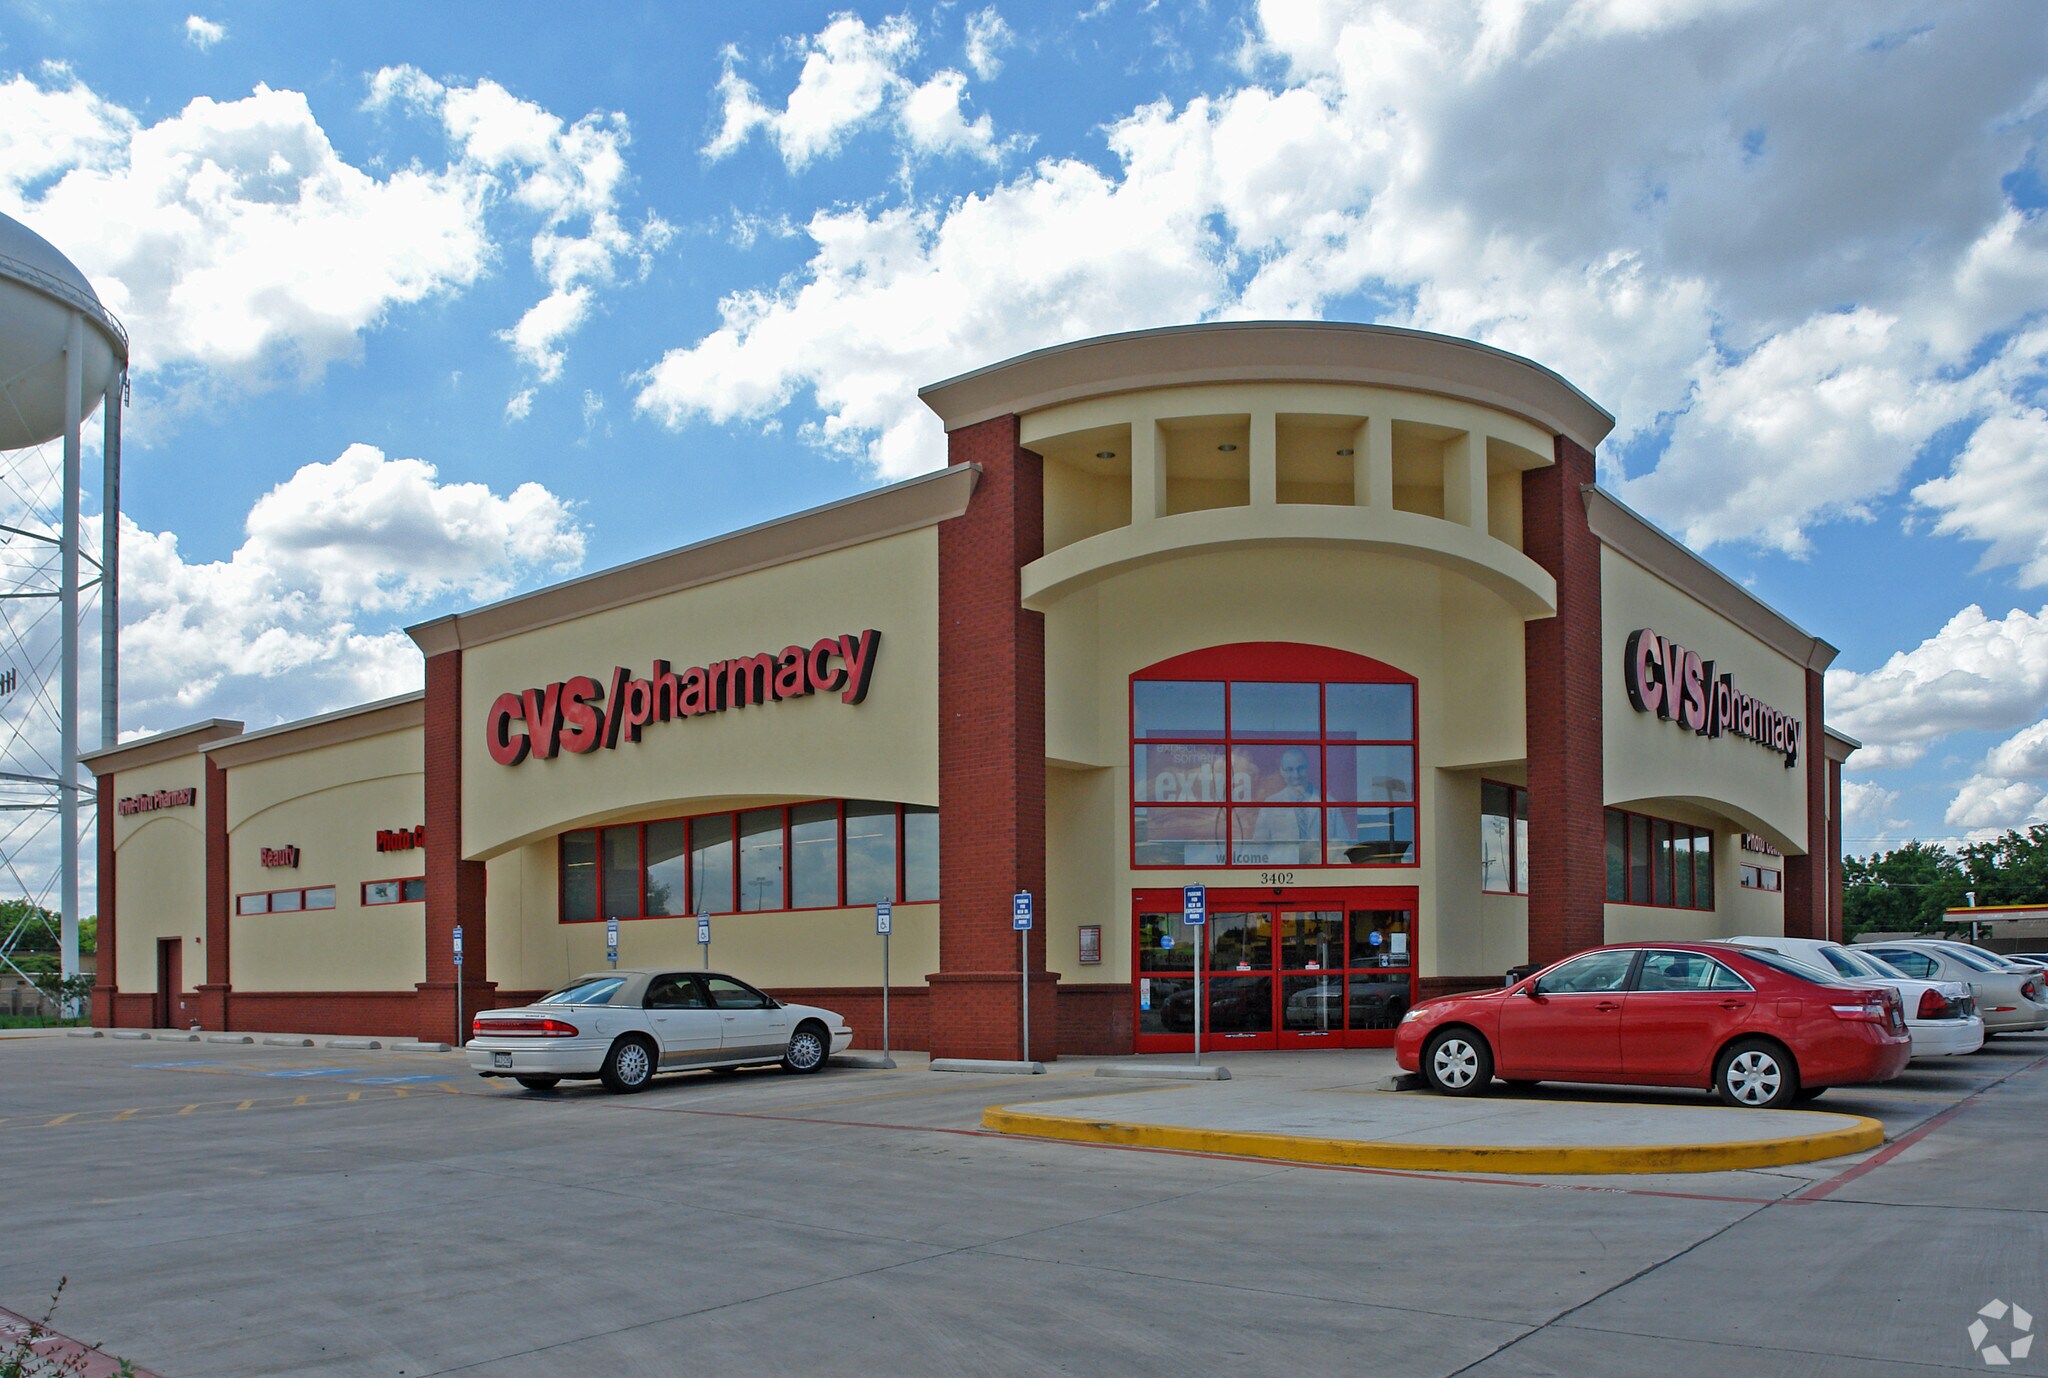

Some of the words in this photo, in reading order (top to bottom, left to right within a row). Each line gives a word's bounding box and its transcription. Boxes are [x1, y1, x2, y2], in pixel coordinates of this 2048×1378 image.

[486, 629, 882, 766] CVS/pharmacy
[1624, 628, 1801, 768] CVS/pharmacy
[376, 828, 414, 852] Photo
[261, 844, 300, 868] Beauty
[1216, 850, 1269, 864] wlcome
[1260, 872, 1294, 885] 3402
